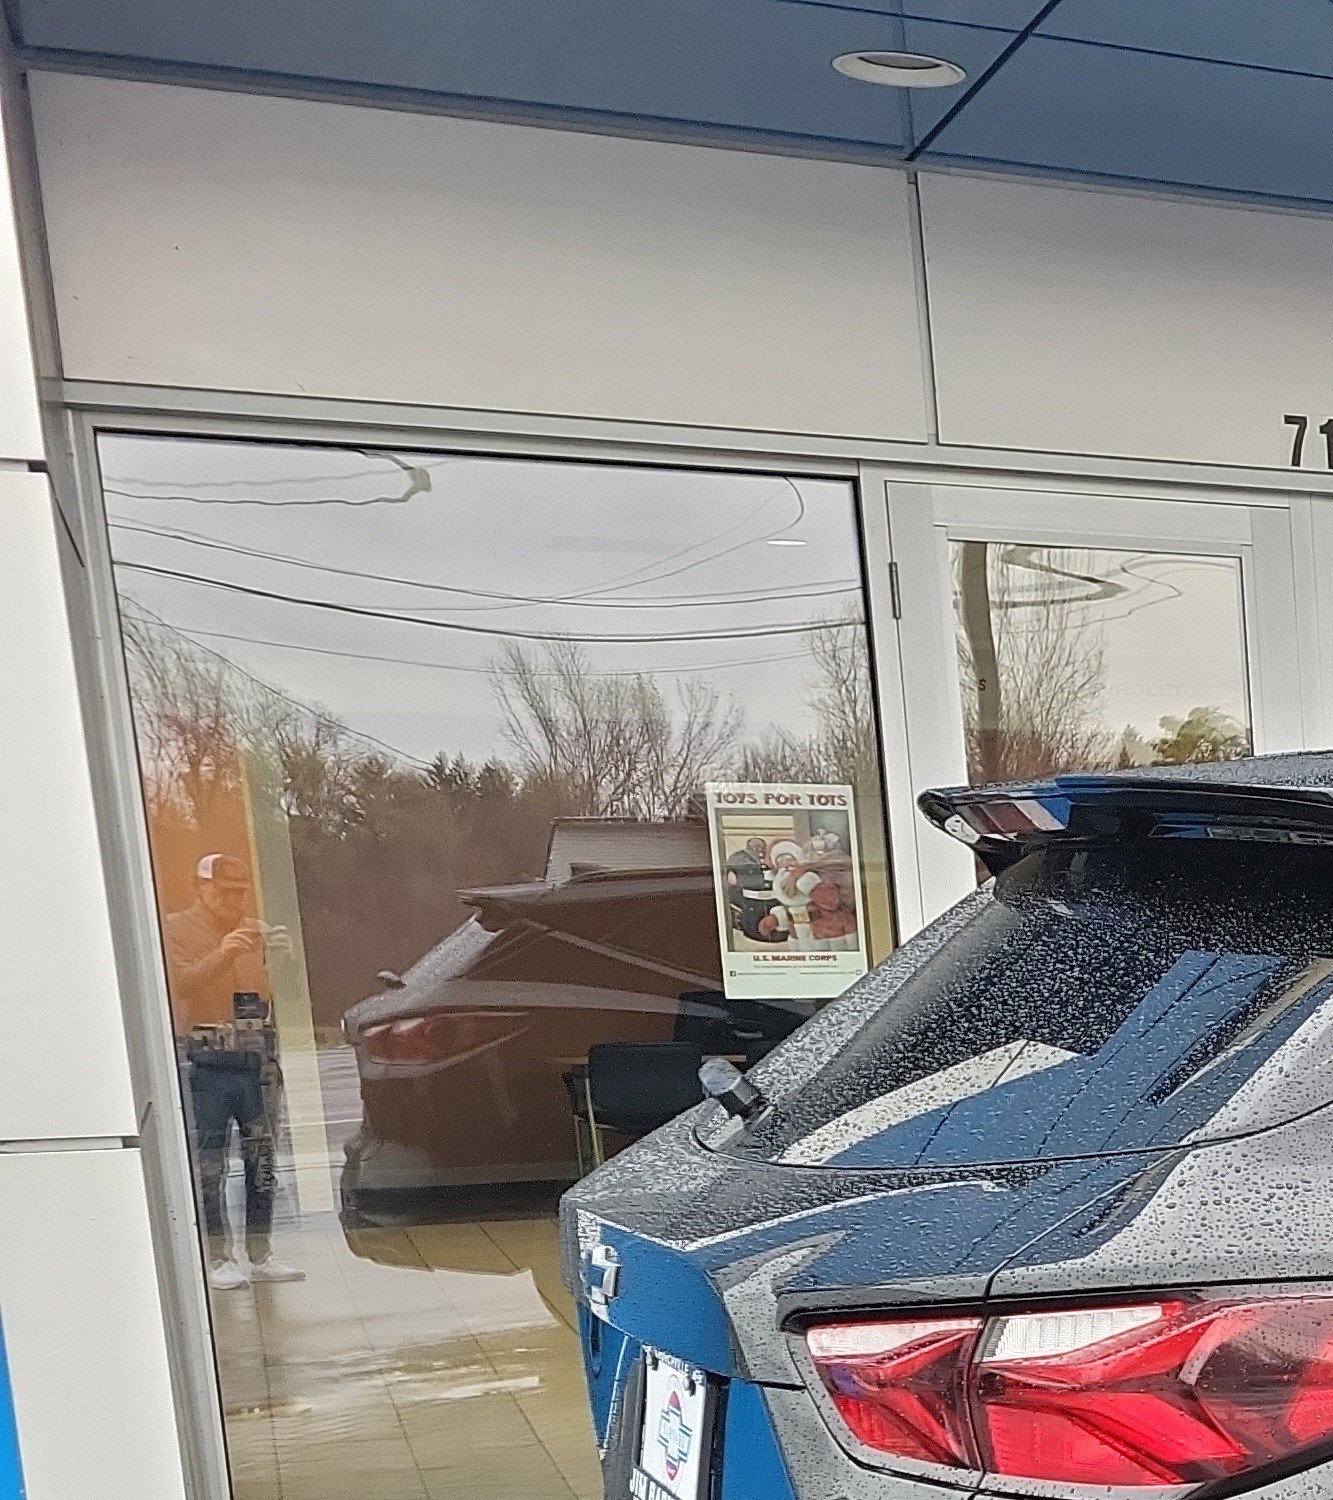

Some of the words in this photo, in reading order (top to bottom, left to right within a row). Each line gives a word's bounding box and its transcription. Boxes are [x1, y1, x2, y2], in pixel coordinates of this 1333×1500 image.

[714, 792, 757, 804] TOYS
[807, 794, 848, 807] TOTS
[629, 1467, 649, 1500] JIM
